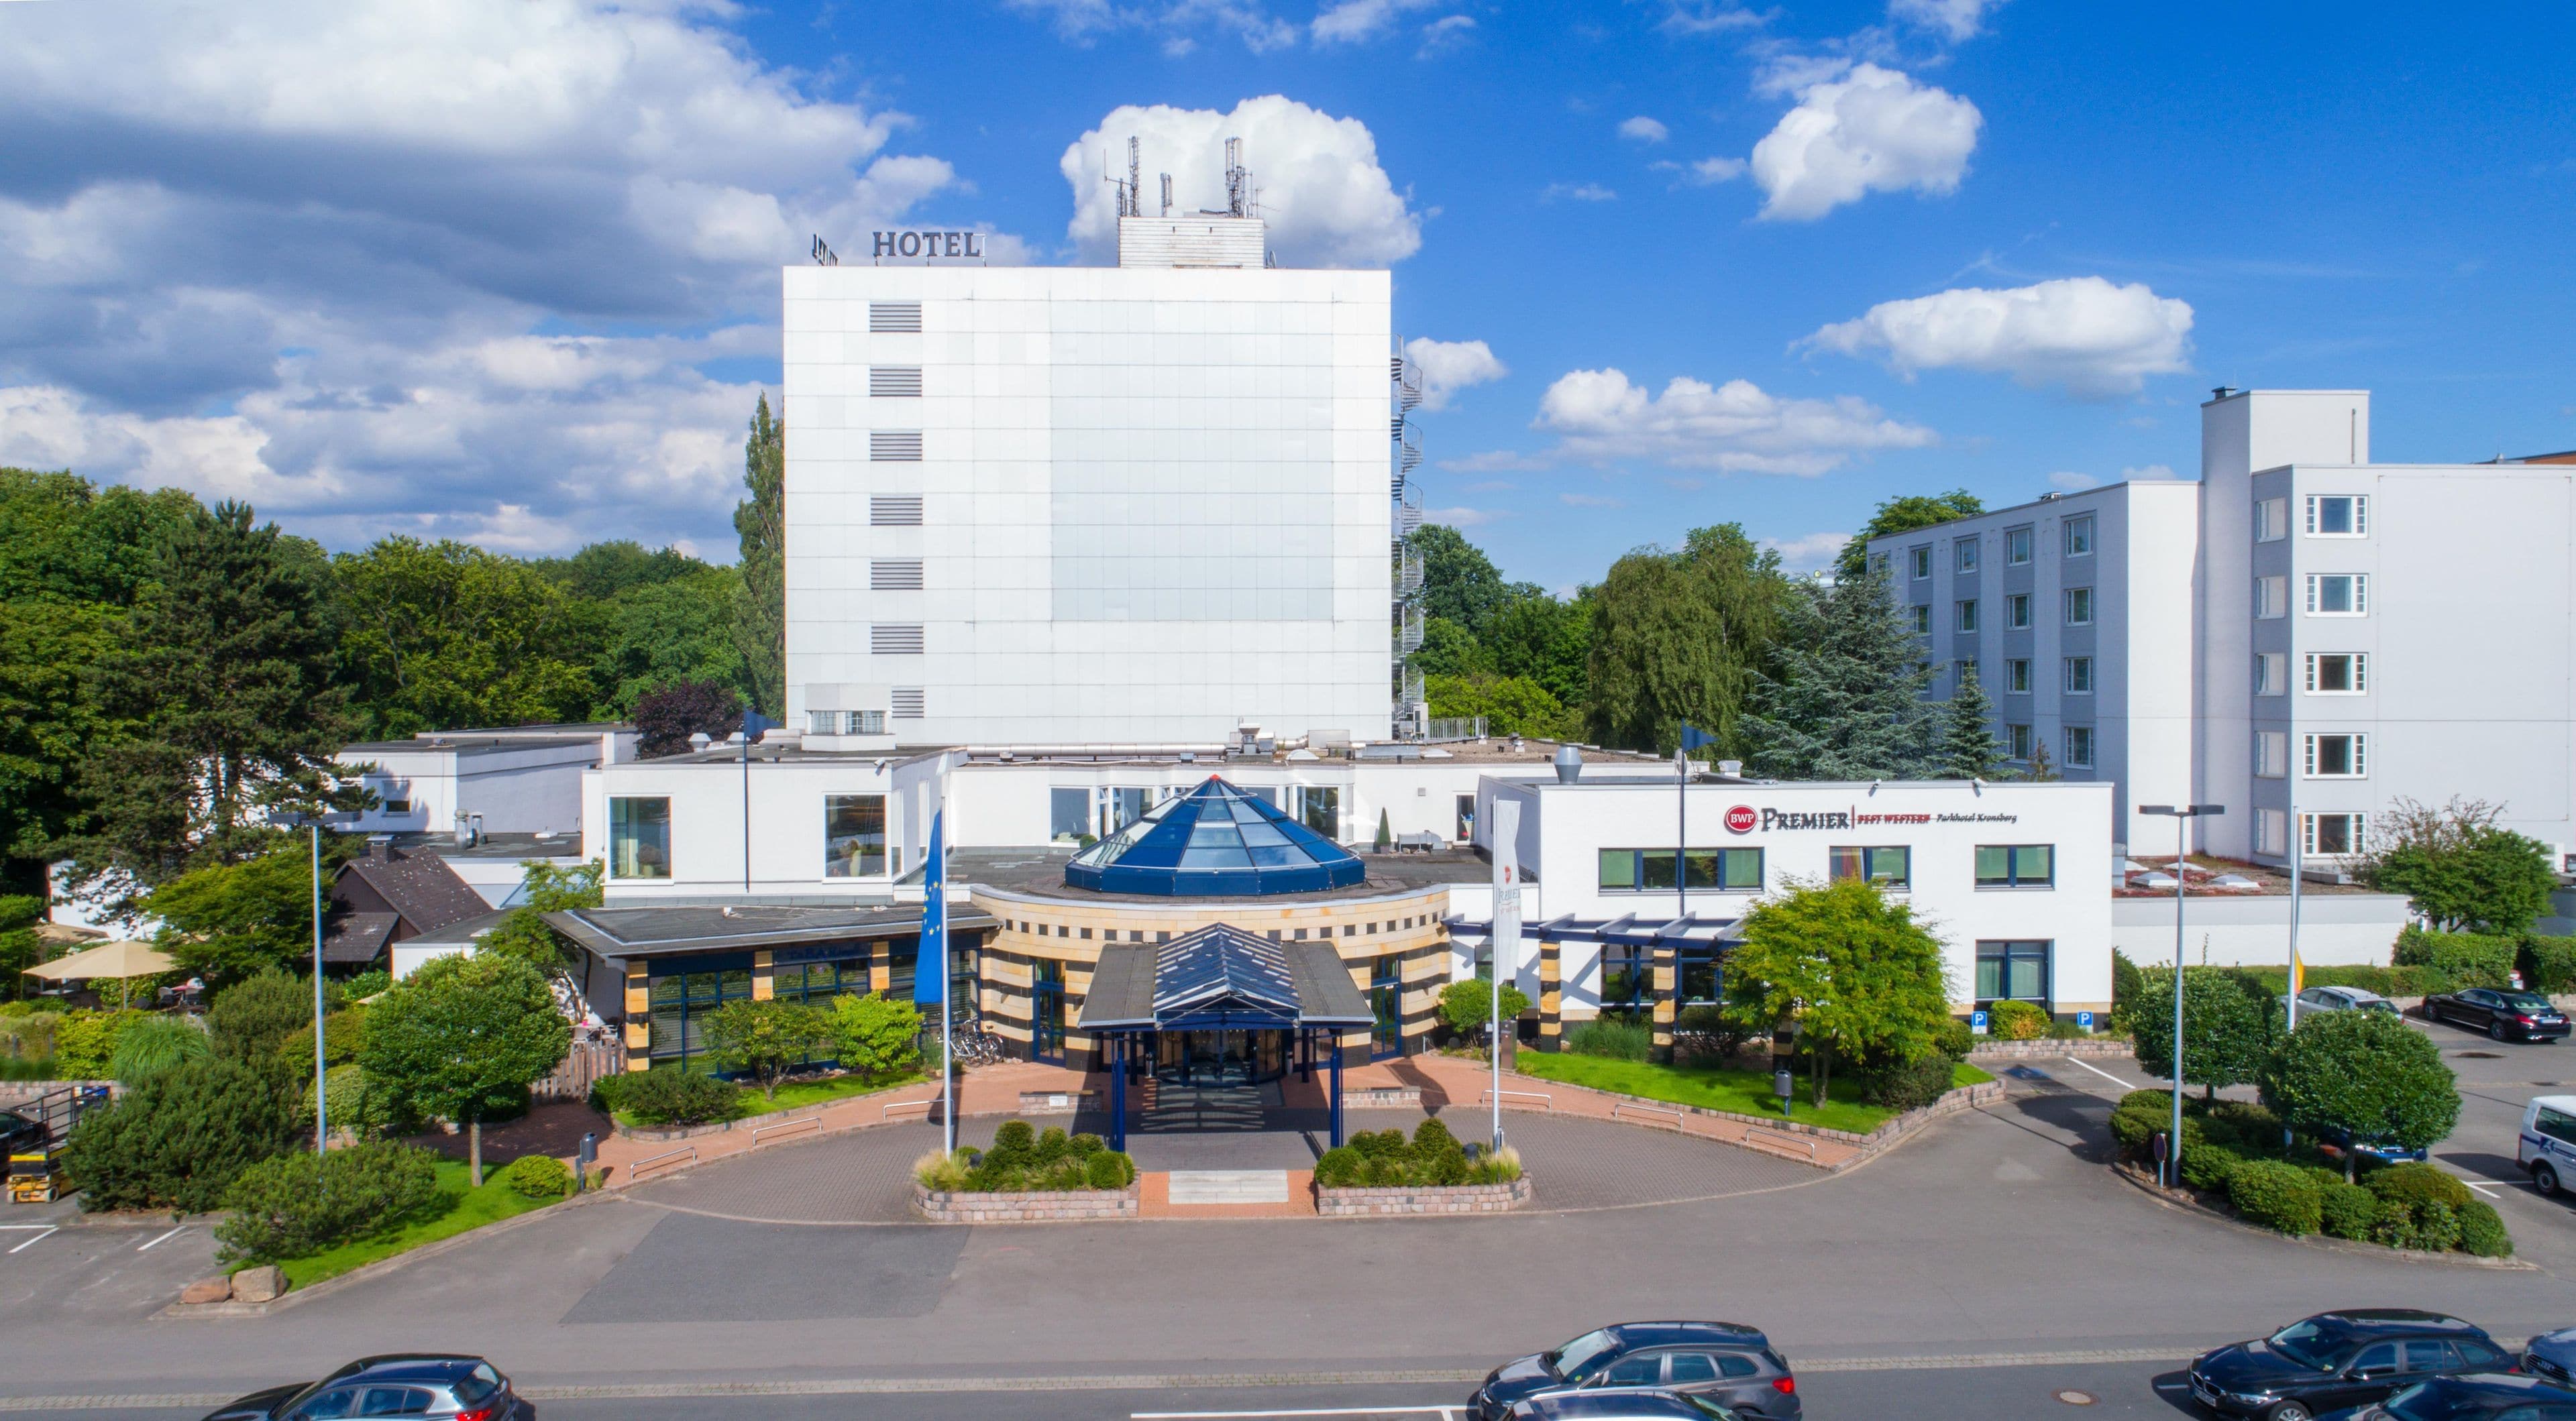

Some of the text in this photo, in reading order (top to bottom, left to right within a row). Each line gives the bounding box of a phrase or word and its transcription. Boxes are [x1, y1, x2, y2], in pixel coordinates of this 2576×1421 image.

[873, 231, 980, 257] HOTEL
[1730, 813, 1754, 823] BWP
[1761, 807, 2018, 832] PREMIER BEST WESTERN Parkhotel Kronsberg
[1975, 1015, 1984, 1025] P
[2081, 1013, 2090, 1025] P
